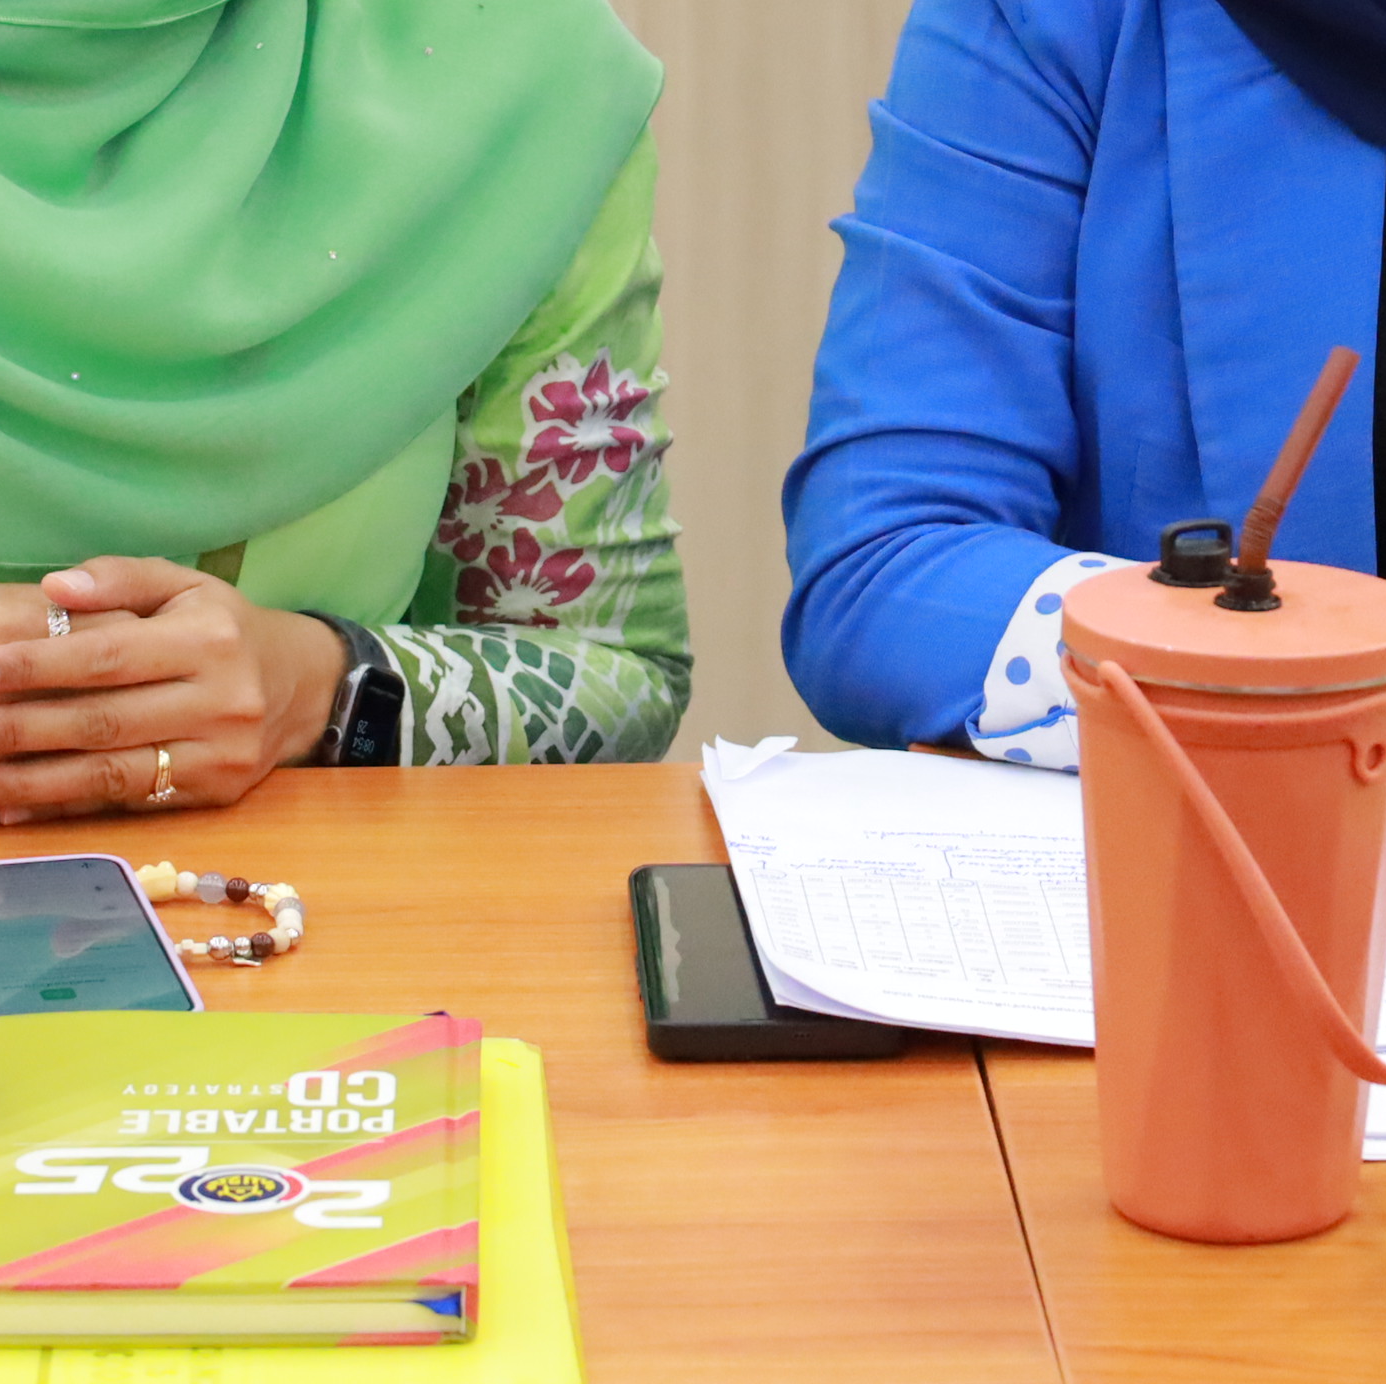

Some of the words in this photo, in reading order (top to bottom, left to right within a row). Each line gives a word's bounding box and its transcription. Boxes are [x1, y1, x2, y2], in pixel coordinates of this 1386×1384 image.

[121, 1082, 284, 1096] STRATEGY
[286, 1069, 398, 1107] CD
[117, 1107, 396, 1135] PORTABLE
